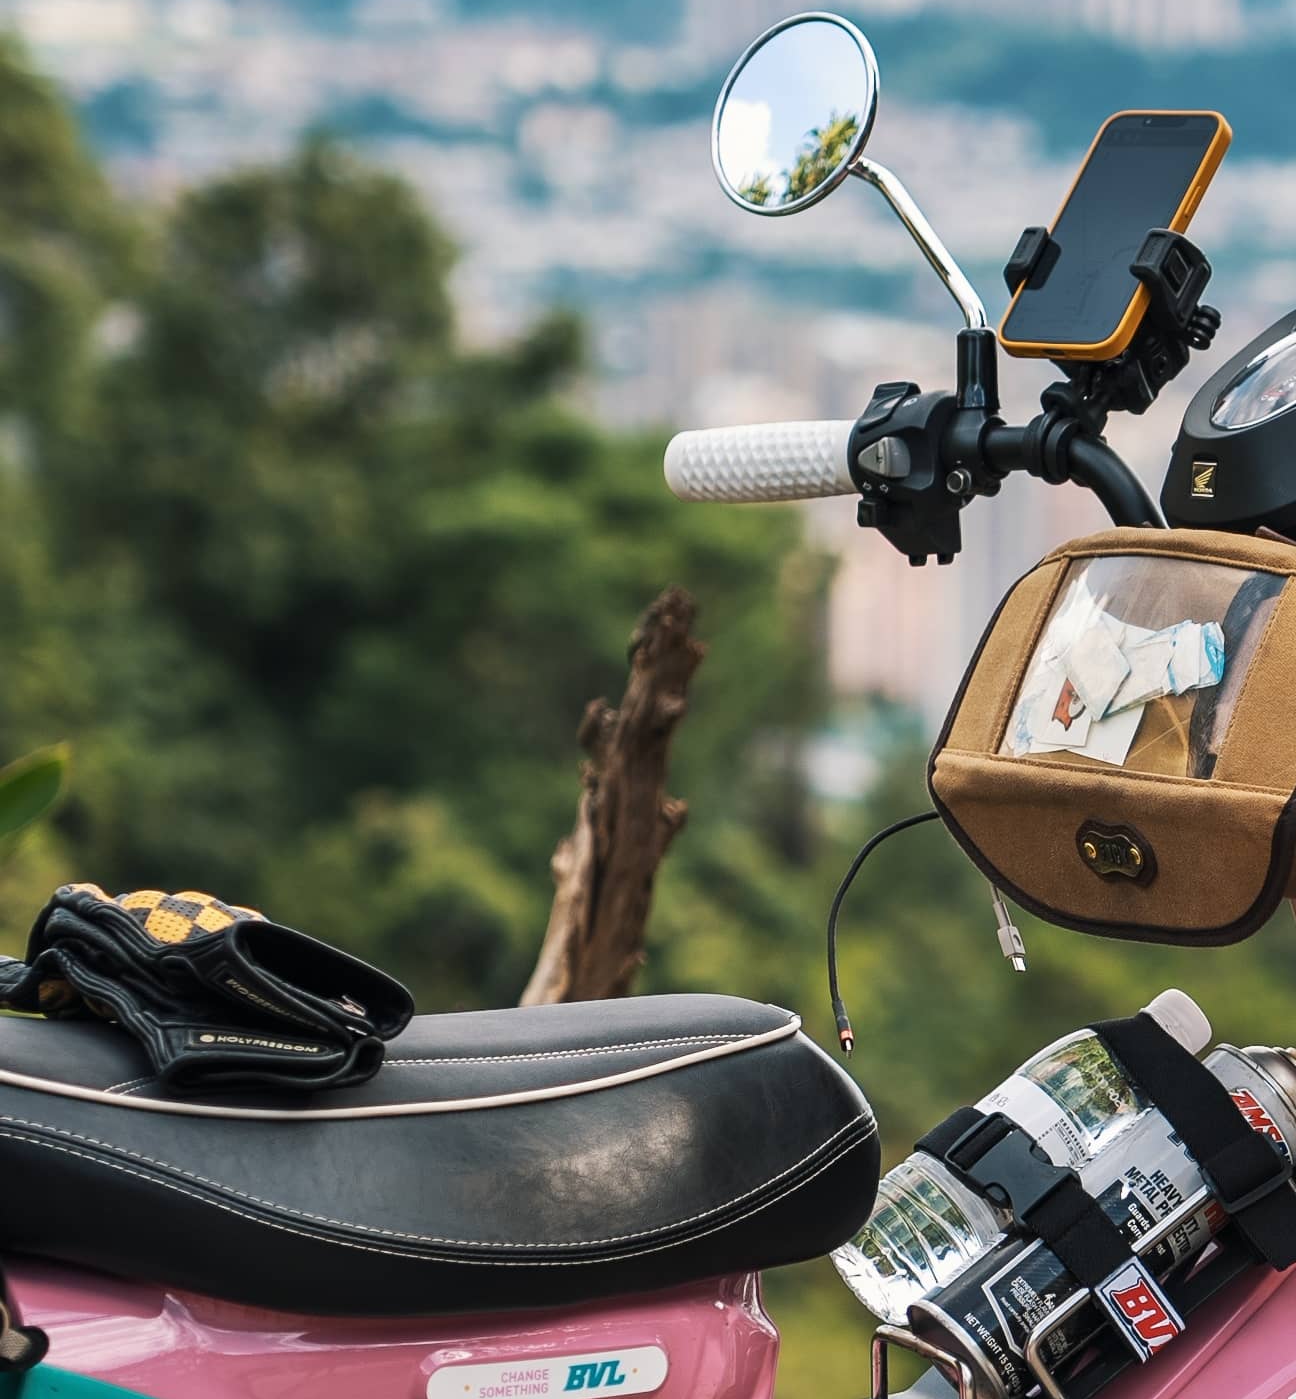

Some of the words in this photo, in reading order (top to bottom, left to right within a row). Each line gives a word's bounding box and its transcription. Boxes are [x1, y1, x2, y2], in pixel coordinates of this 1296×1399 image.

[1149, 1169, 1184, 1208] HEAVY
[1127, 1203, 1150, 1230] Guards
[1110, 1278, 1179, 1356] BV
[963, 1313, 980, 1328] NET
[976, 1325, 1002, 1354] WEIGHT
[999, 1353, 1008, 1365] 15
[479, 1382, 549, 1399] SOMETHING
[501, 1368, 549, 1384] CHANGE
[563, 1360, 626, 1391] BVL
